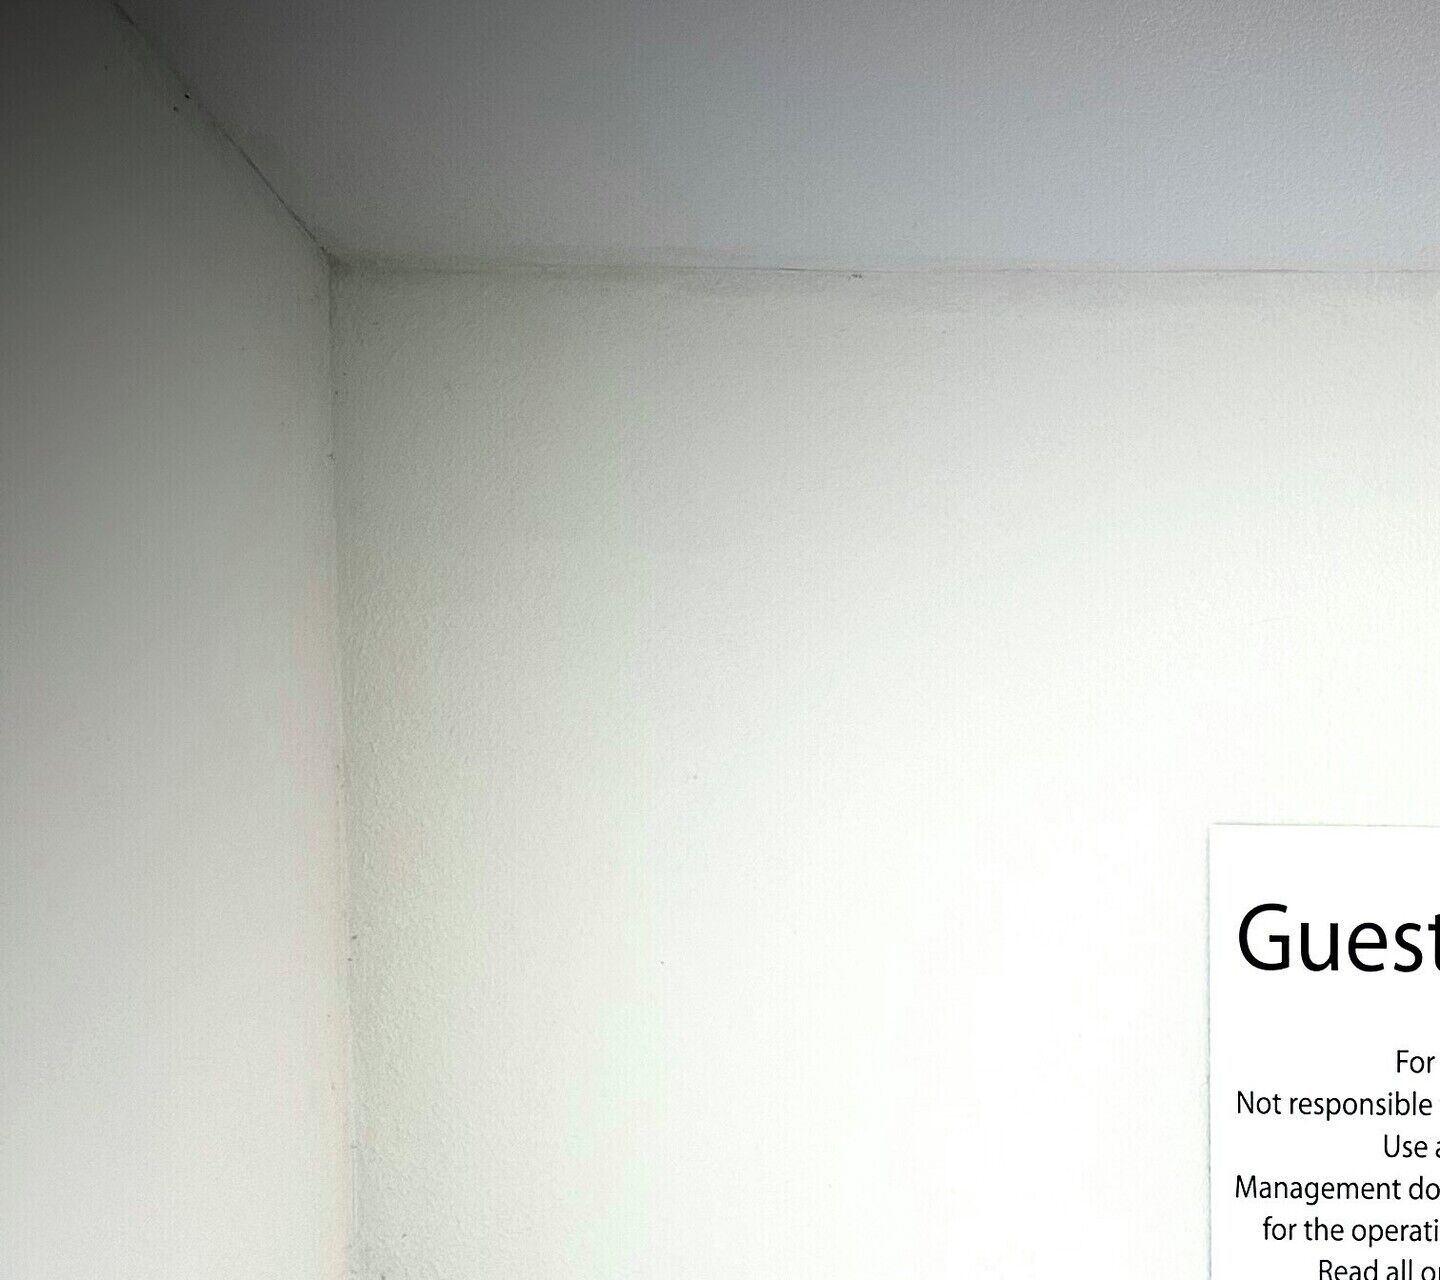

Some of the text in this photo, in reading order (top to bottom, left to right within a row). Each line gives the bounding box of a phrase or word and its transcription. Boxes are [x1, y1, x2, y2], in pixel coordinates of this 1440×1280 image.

[1396, 1049, 1436, 1074] For
[1237, 1090, 1282, 1115] Not
[1289, 1090, 1433, 1122] responsible
[1384, 1133, 1428, 1159] Use
[1235, 1174, 1402, 1206] Management
[1262, 1215, 1298, 1241] for
[1303, 1216, 1345, 1242] the
